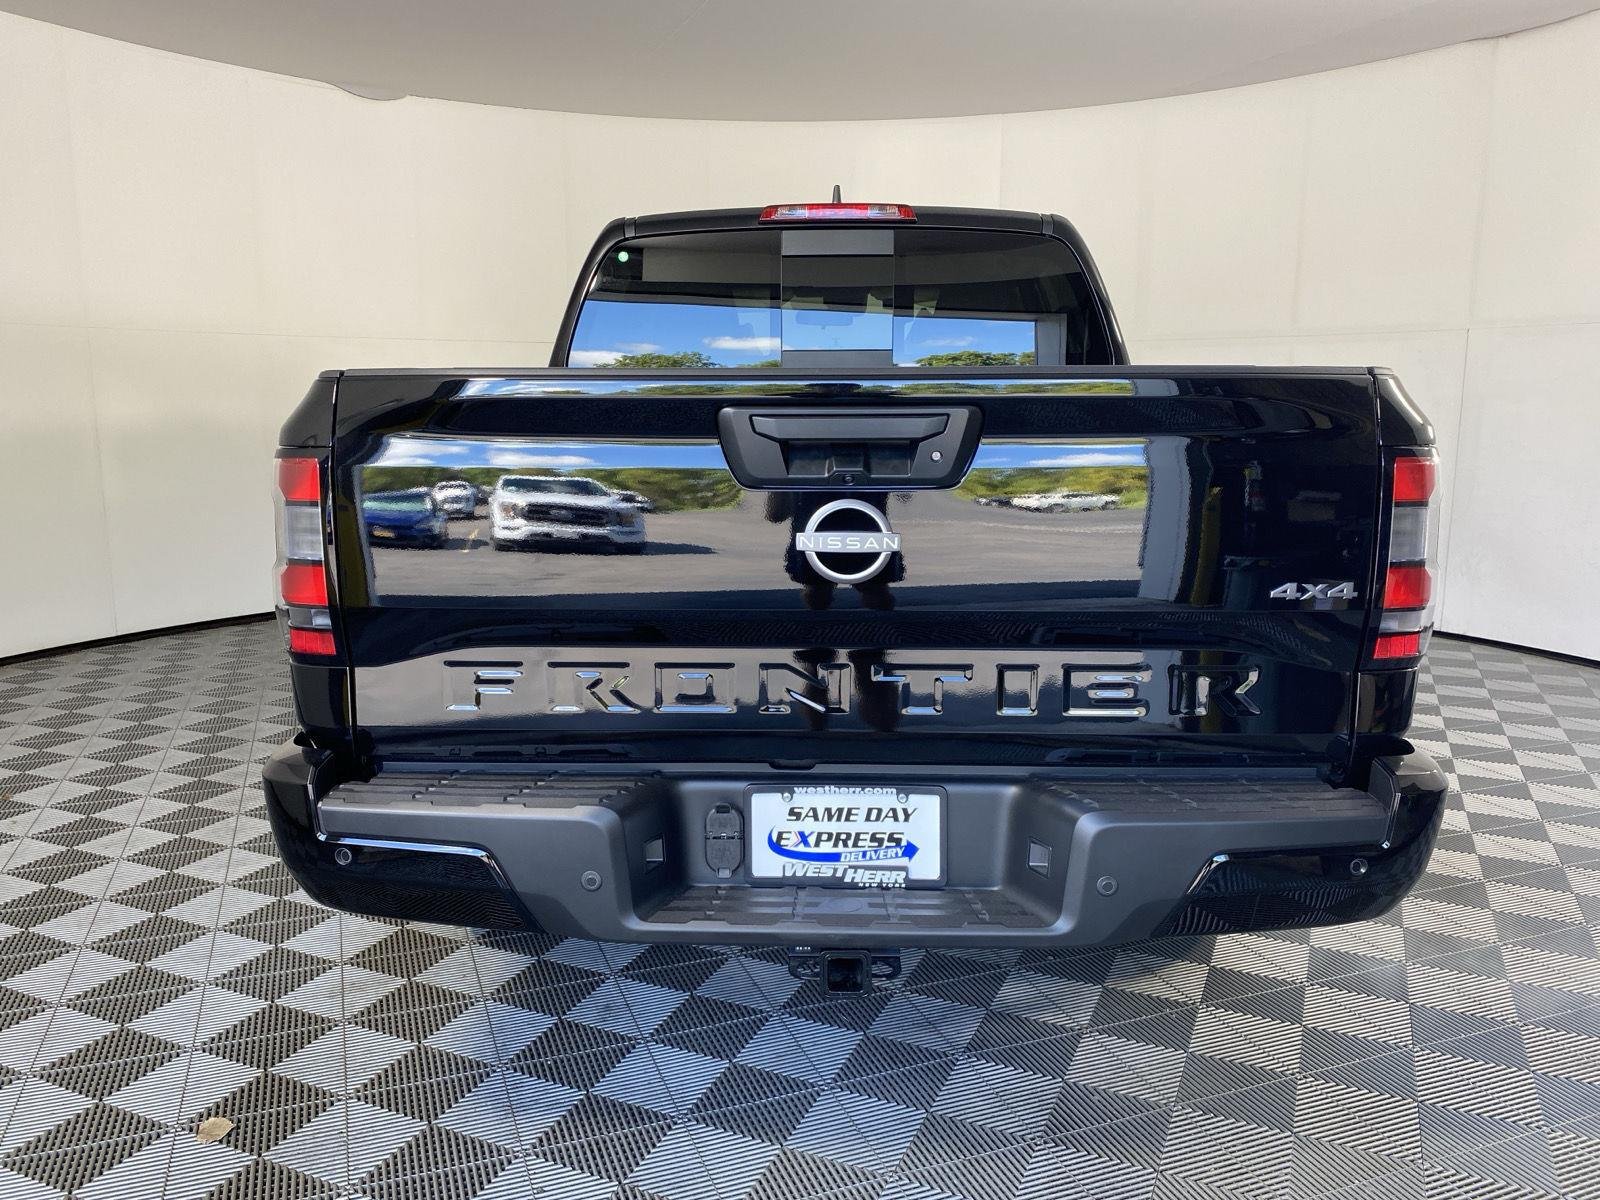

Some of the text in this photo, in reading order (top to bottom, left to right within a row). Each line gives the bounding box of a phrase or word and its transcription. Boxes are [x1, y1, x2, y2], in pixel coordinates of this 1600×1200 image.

[799, 536, 898, 549] NISSAN
[444, 660, 1262, 716] FRONTIER
[794, 786, 897, 796] westherr.com
[787, 807, 917, 822] SAME DAY
[775, 831, 905, 848] EXPRESS
[840, 848, 904, 862] DELIVERY
